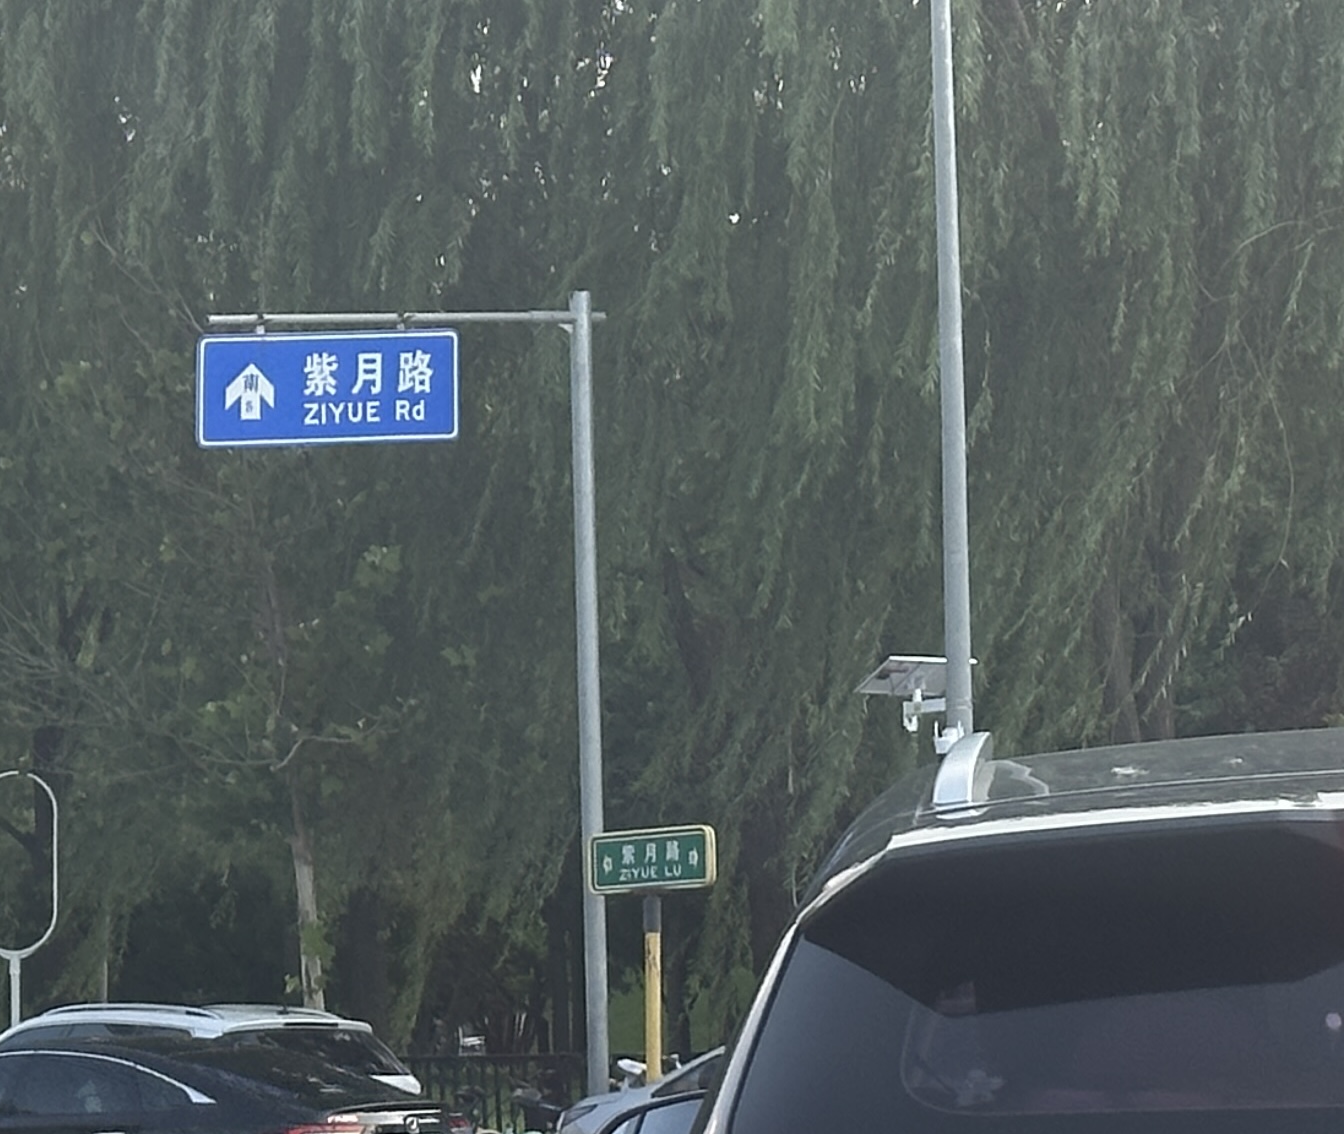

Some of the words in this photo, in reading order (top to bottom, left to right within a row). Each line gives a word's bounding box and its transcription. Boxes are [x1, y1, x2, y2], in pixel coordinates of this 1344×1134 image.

[303, 349, 434, 397] 紫月路
[303, 400, 381, 426] ZIYUE
[394, 399, 426, 422] Rd
[619, 865, 659, 882] ZIYUE
[664, 863, 682, 878] LU
